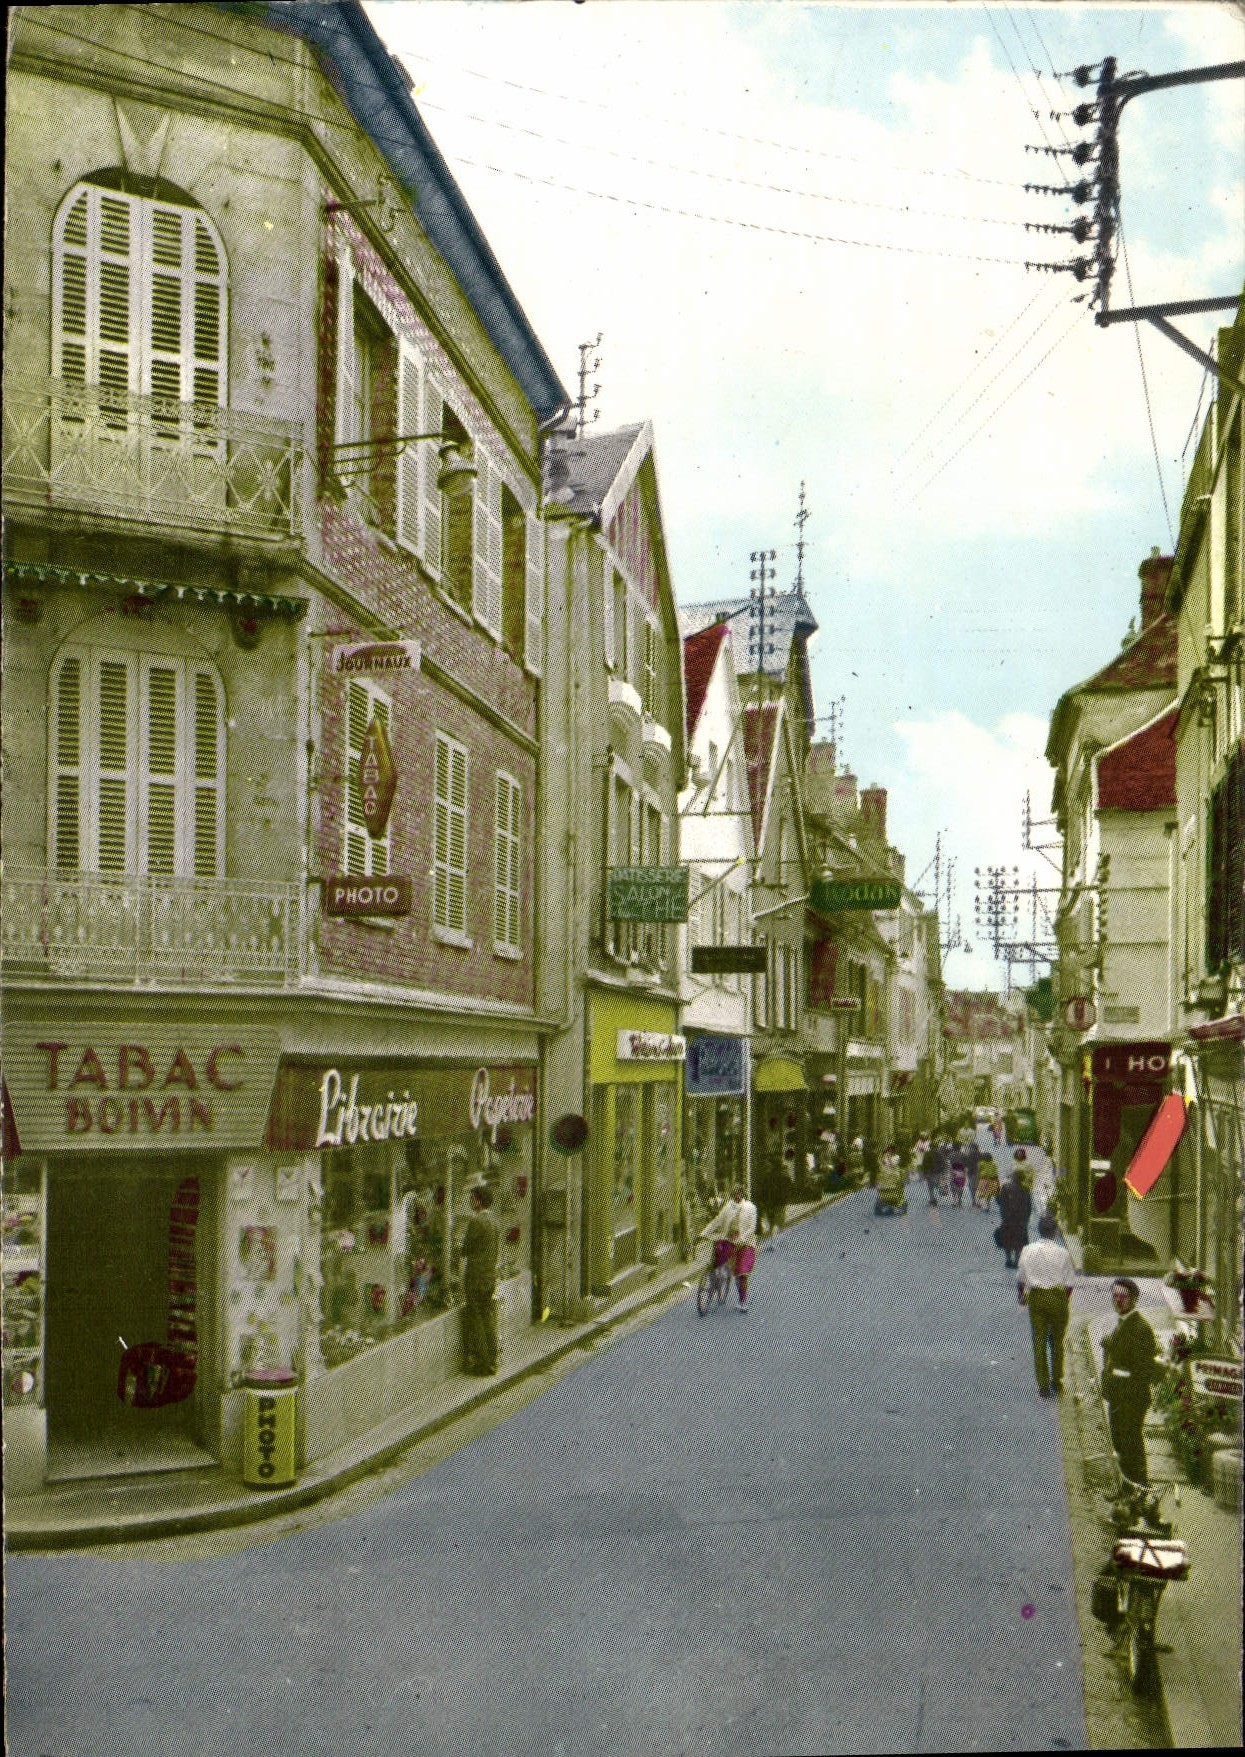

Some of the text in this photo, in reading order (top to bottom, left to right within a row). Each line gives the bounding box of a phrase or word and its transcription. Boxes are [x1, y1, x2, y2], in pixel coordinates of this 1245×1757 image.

[362, 737, 380, 816] TABAC
[335, 887, 399, 904] PHOTO
[36, 1042, 244, 1091] TABAC
[316, 1069, 418, 1147] Librairie
[258, 1397, 276, 1478] PHOTO
